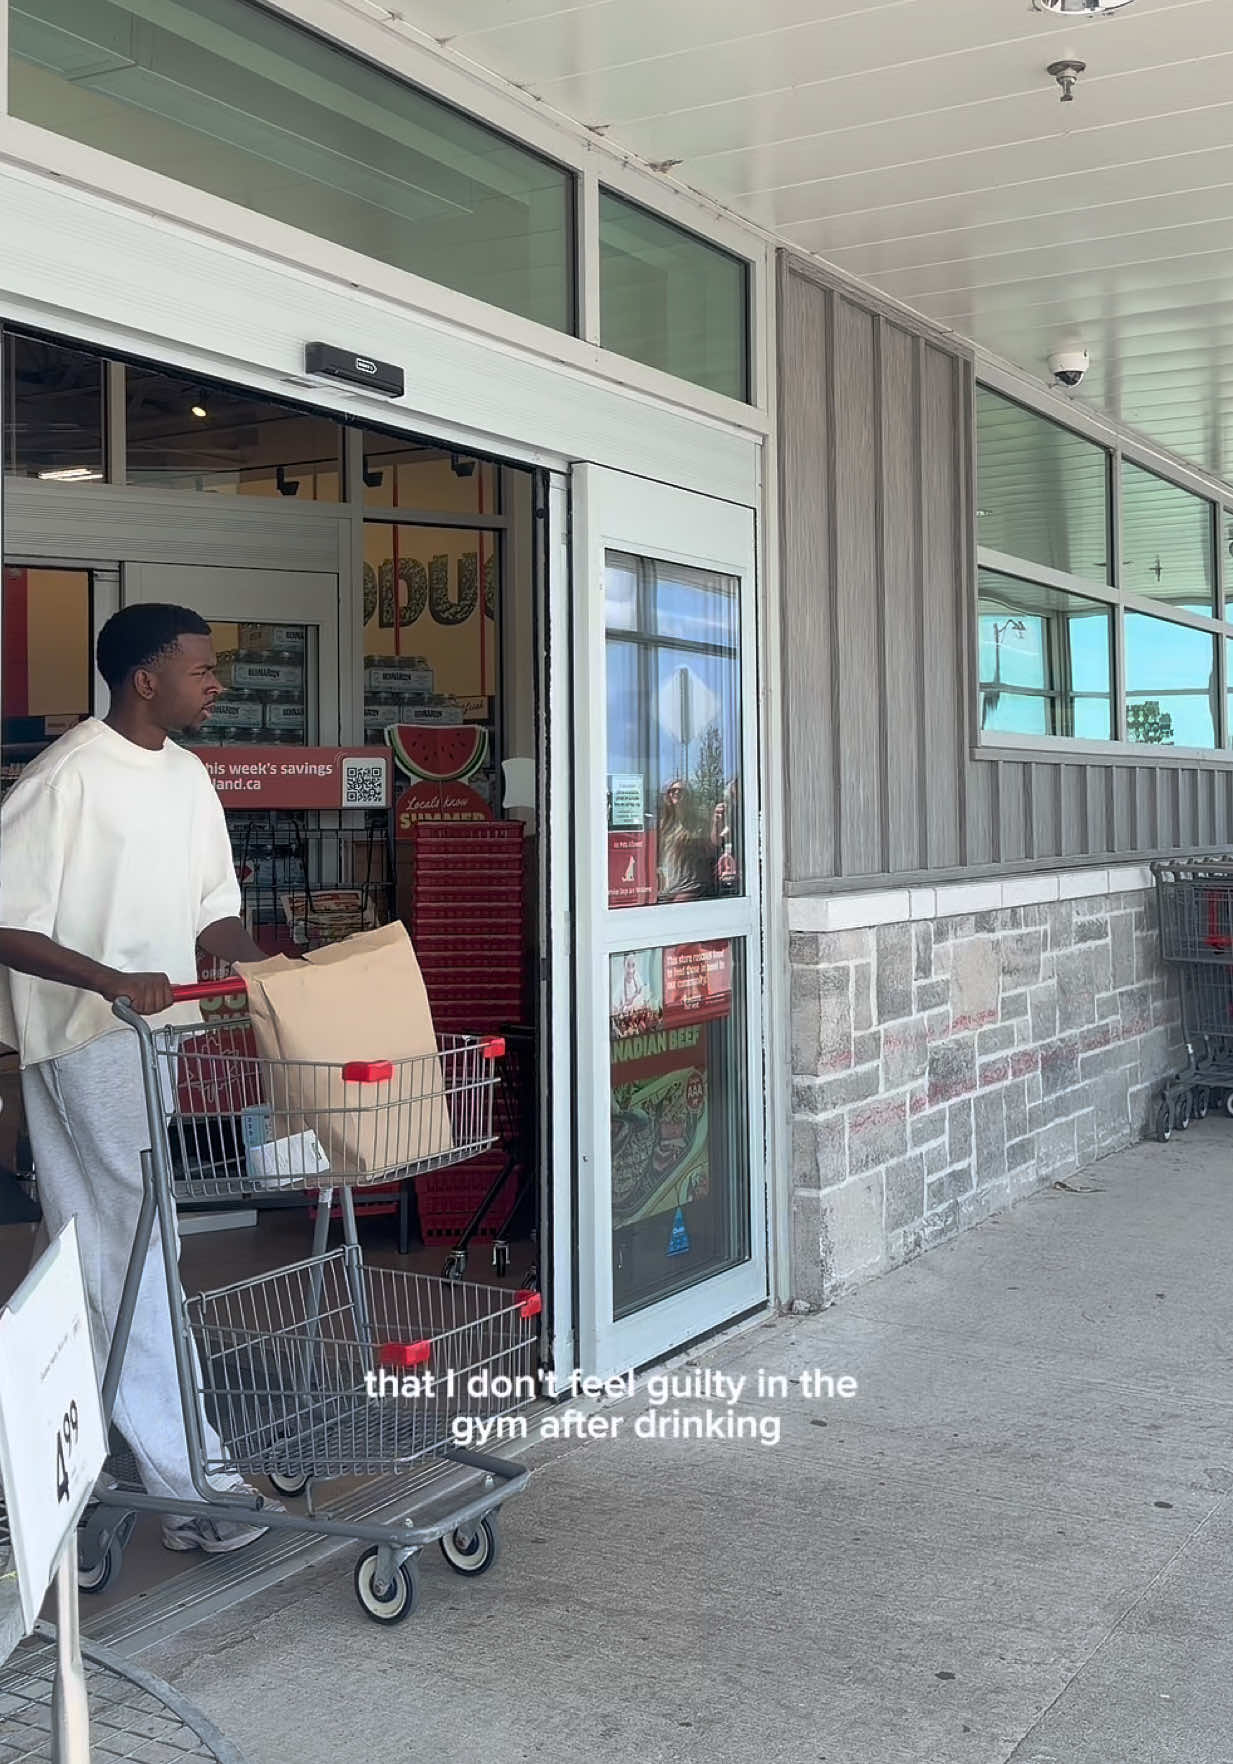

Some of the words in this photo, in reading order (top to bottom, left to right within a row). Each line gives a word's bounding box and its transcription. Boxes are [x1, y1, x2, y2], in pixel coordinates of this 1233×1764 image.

[205, 762, 226, 775] his
[229, 762, 278, 775] week's
[280, 762, 333, 777] savings
[211, 778, 262, 790] land.ca
[612, 1031, 667, 1064] NADIAN
[688, 1085, 703, 1099] AAA
